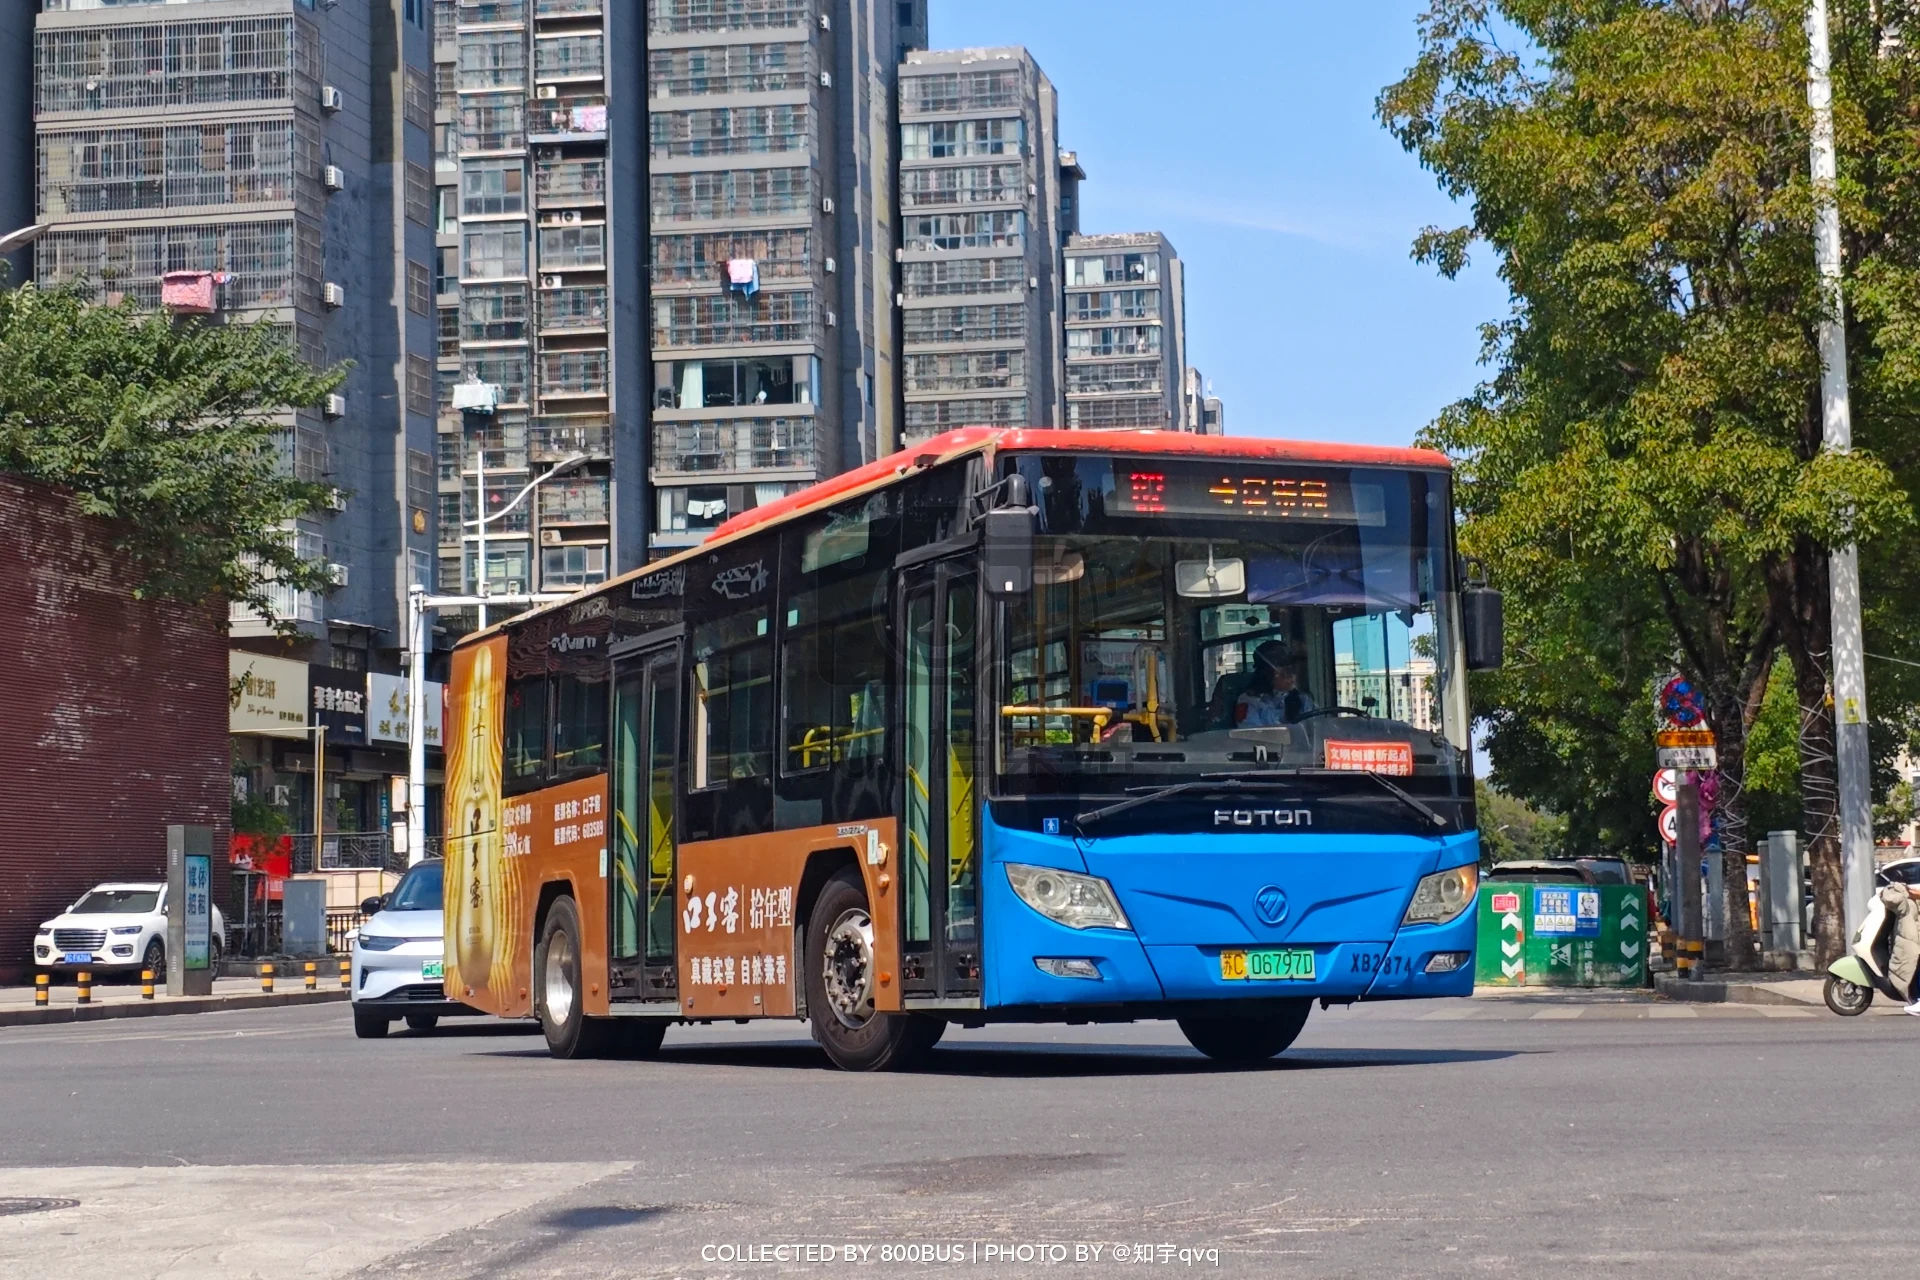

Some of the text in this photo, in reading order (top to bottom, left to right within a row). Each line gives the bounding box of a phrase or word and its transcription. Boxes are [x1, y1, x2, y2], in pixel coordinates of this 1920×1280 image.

[1330, 747, 1408, 762] 文明创建新起点
[1213, 808, 1312, 826] FOTON
[750, 885, 793, 929] 拾年型
[690, 955, 786, 985] 真藏实窖 自然兼香
[1350, 952, 1412, 976] XB2874
